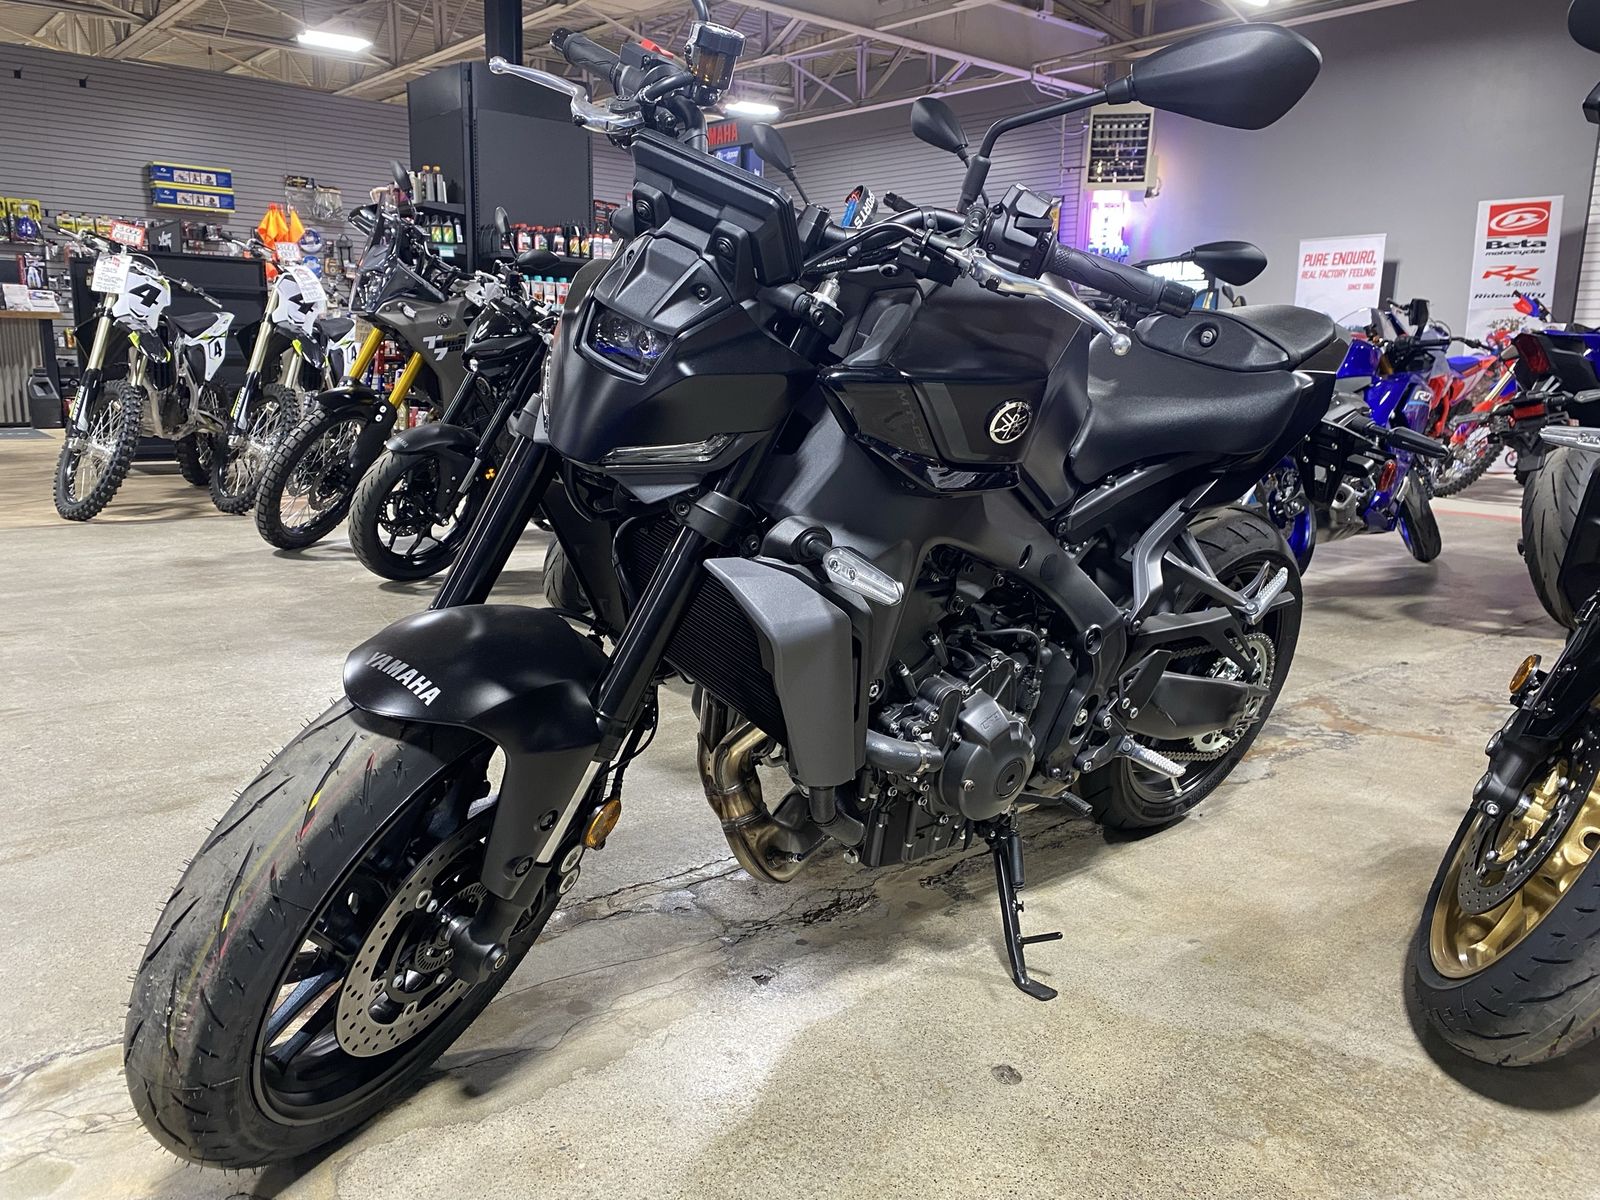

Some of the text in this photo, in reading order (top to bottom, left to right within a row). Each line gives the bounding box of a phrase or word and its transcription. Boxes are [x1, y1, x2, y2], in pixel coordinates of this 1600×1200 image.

[708, 123, 737, 145] MAHA
[1486, 239, 1547, 250] Beta
[1303, 250, 1376, 267] PURE ENDURO,
[1301, 267, 1376, 279] REAL FACTORY FEELING
[129, 283, 161, 308] 4
[288, 292, 314, 315] 4
[214, 341, 222, 358] 4
[896, 389, 929, 451] MT-09
[365, 651, 441, 707] YAMAHA
